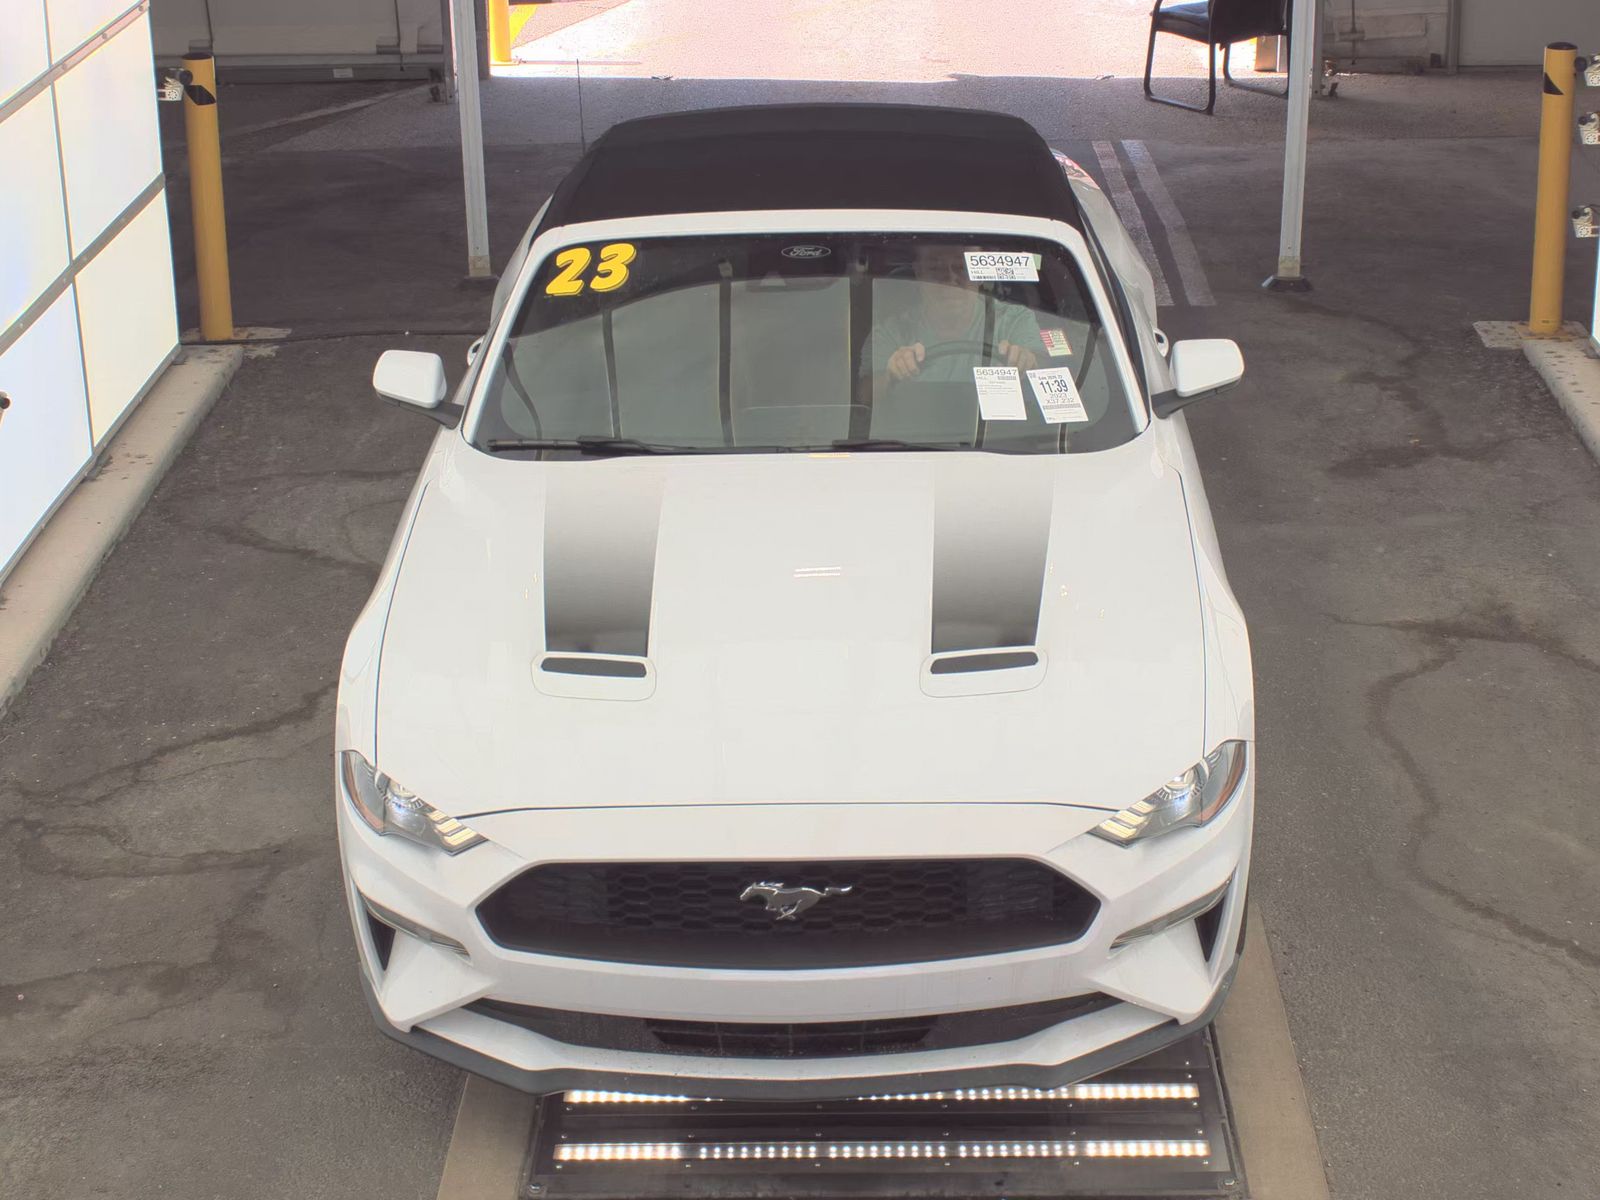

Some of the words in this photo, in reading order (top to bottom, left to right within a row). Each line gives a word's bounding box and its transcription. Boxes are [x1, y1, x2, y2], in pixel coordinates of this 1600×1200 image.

[790, 246, 823, 257] Ford
[970, 255, 1030, 267] 5634947
[545, 242, 637, 297] 23
[1039, 379, 1069, 394] 11:39
